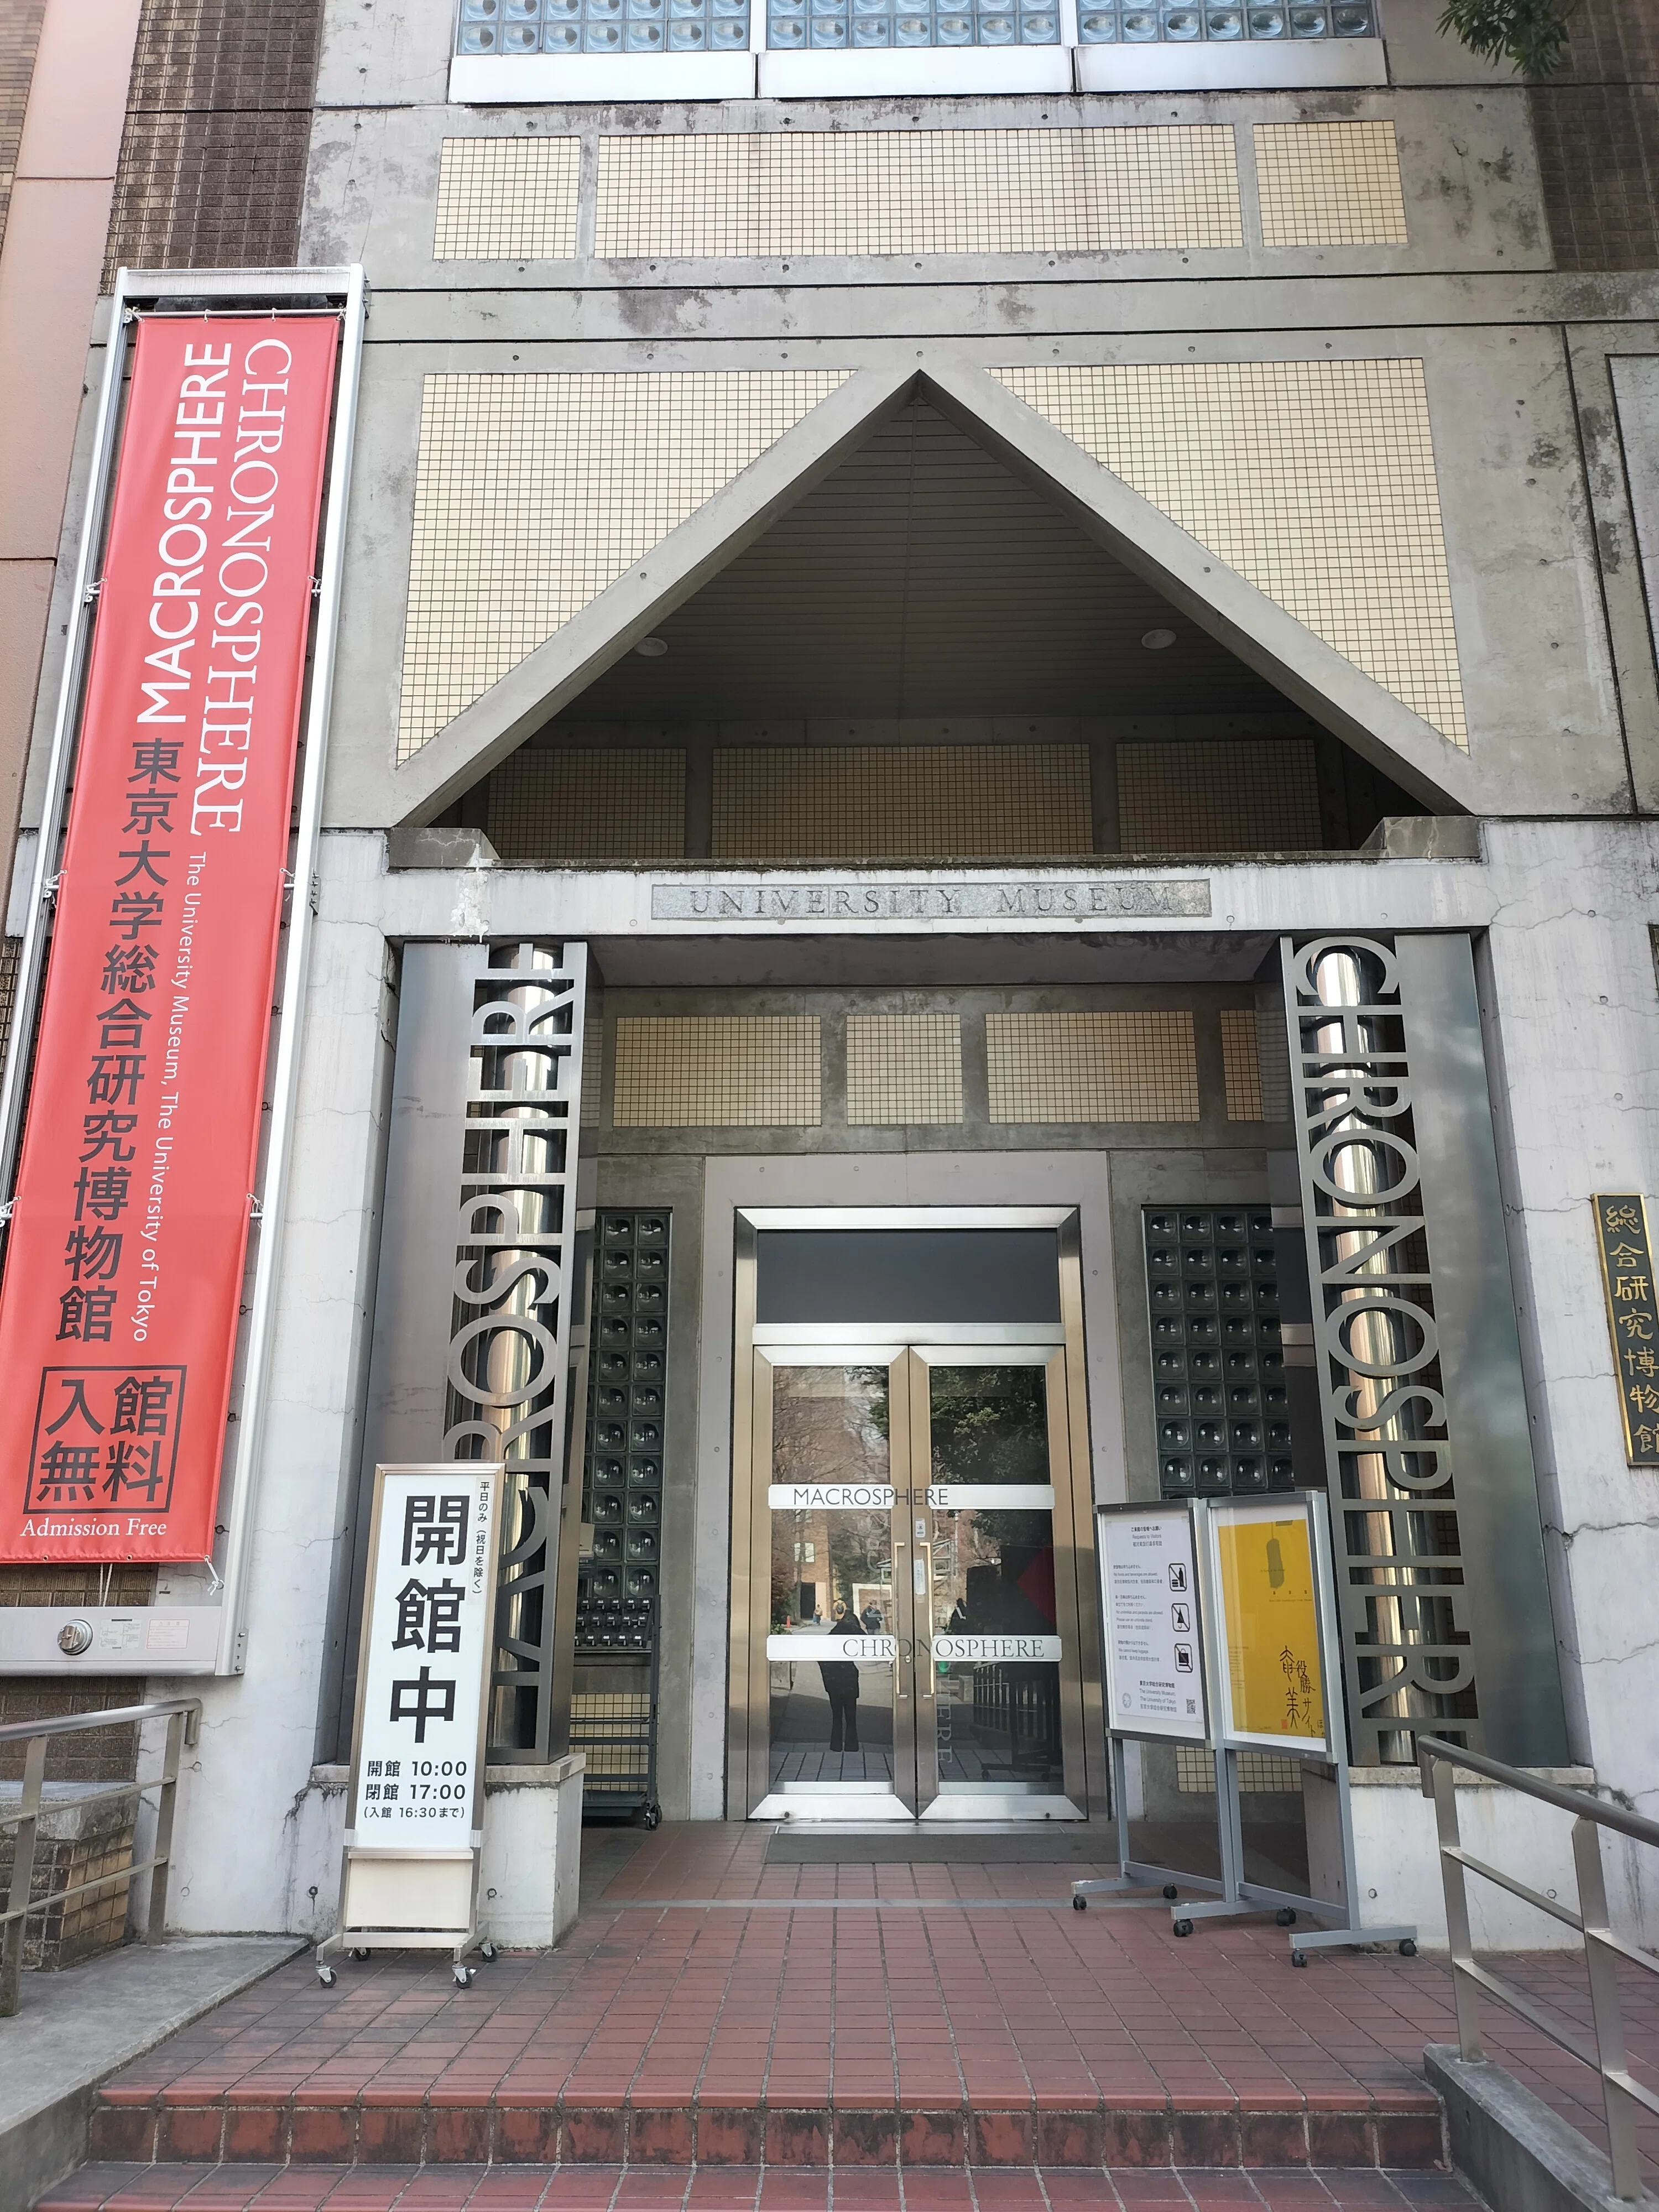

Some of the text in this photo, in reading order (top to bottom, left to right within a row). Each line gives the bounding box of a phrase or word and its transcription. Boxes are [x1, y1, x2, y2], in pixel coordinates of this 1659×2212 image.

[136, 342, 232, 724] MACROSPHERE
[190, 338, 293, 837] CHRONOSPHERE
[689, 885, 1175, 916] UNIVERSITY MUSEUM
[55, 737, 184, 1343] 東京大学総合研究博物館
[133, 851, 207, 1342] The University Museum, The University of Tokyo
[1291, 936, 1474, 1764] CHRONOSPHERE
[45, 1375, 174, 1436] 入館
[36, 1440, 164, 1502] 無料
[794, 1488, 950, 1506] MACROSPHERE
[20, 1516, 167, 1537] Admission Free
[389, 1495, 471, 1744] 開館中
[842, 1639, 1046, 1658] CHRONOSPHERE
[365, 1783, 466, 1801] 閉館 17:00
[367, 1760, 467, 1778] 開館 10:00
